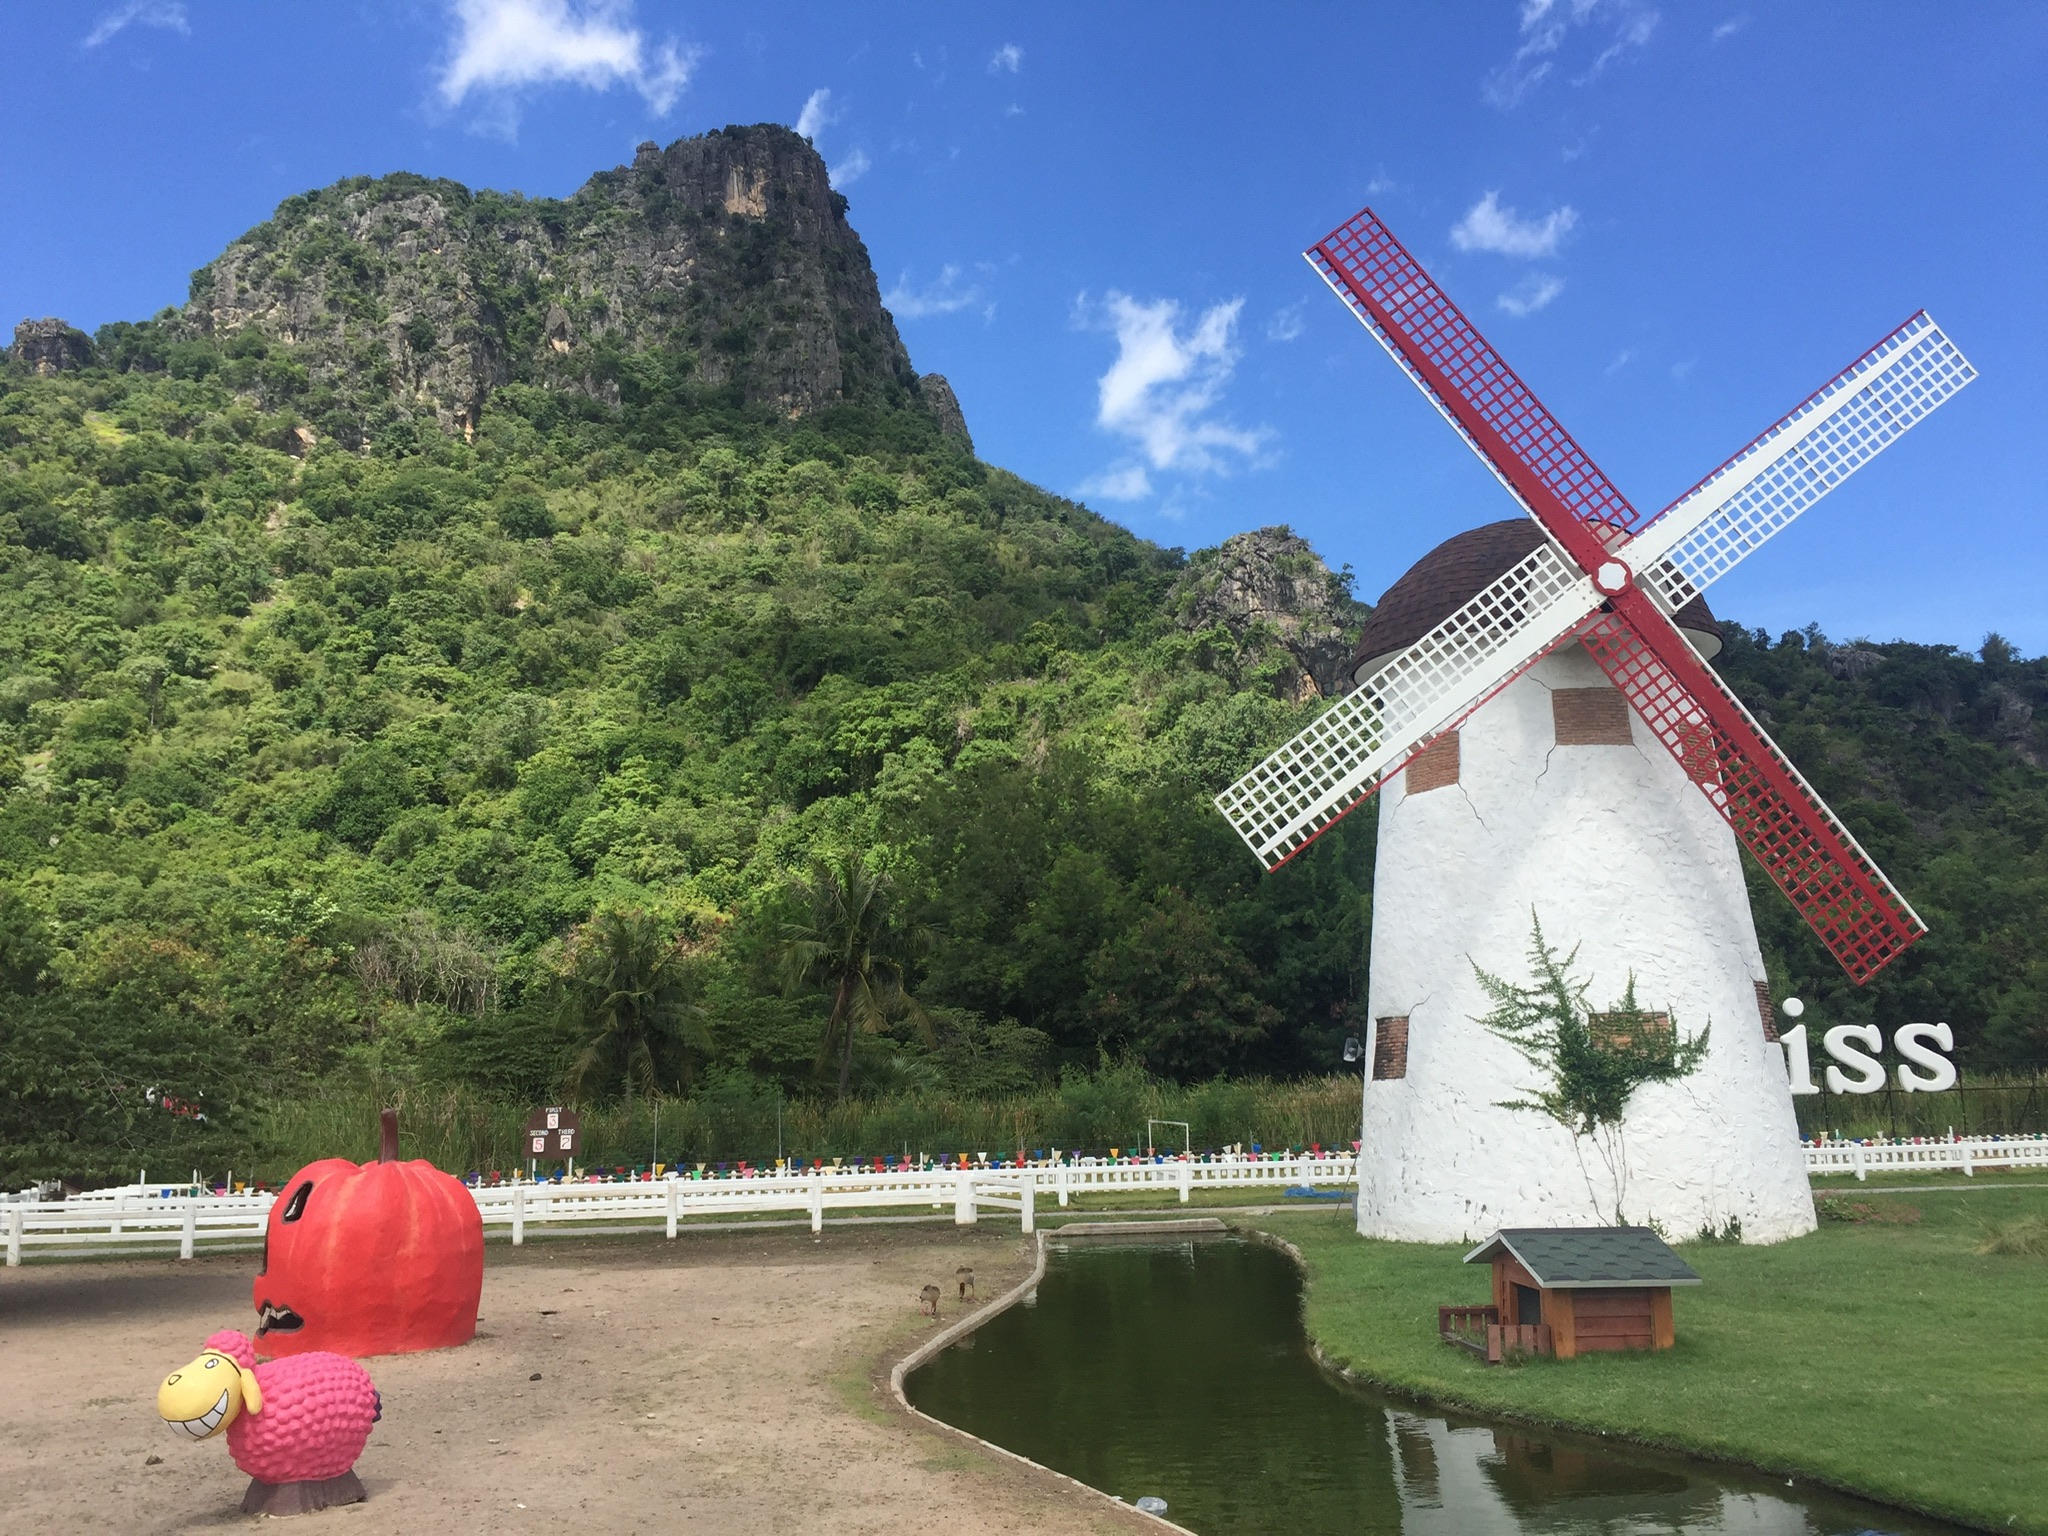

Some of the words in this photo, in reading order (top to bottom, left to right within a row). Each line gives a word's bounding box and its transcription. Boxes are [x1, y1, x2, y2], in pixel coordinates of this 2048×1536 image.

[549, 1115, 556, 1126] 3
[535, 1139, 543, 1150] 5
[562, 1137, 570, 1148] 7
